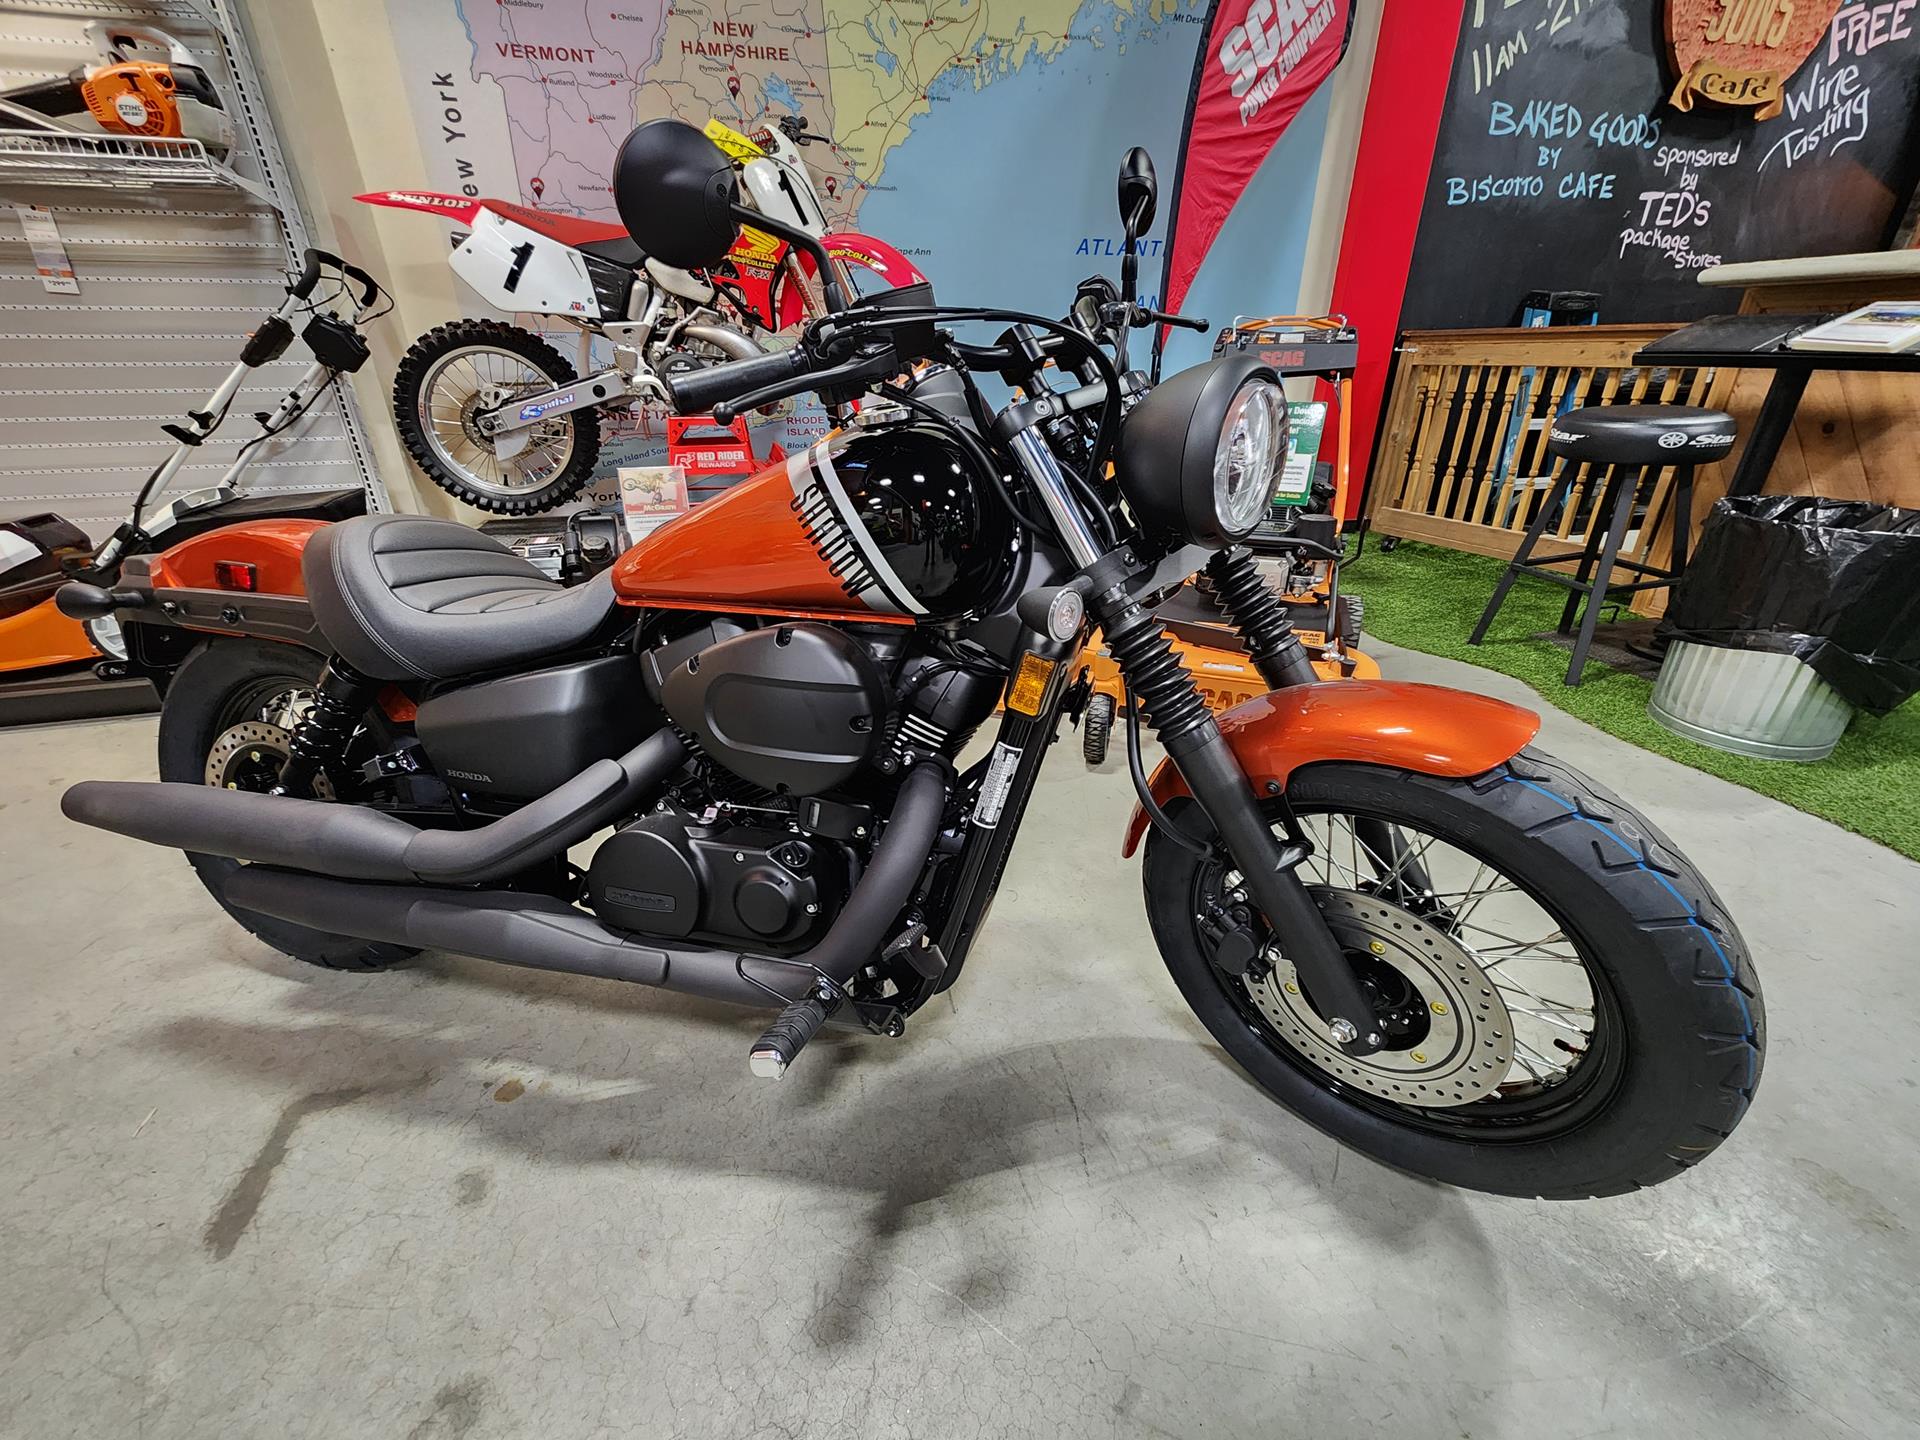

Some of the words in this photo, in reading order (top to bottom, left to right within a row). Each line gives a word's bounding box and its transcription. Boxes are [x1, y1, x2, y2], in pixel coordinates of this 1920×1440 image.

[617, 13, 644, 22] Chelsea
[1174, 13, 1185, 23] Mt
[1185, 14, 1206, 24] Dese
[713, 21, 754, 38] NEW
[1828, 0, 1917, 66] FREE
[496, 42, 595, 64] VERMONT
[681, 40, 790, 61] HAMPSHIRE
[1219, 0, 1319, 97] SCA
[549, 79, 575, 87] Rutland
[588, 70, 624, 79] Woodstock
[1239, 67, 1279, 127] POWER
[1785, 63, 1861, 121] Wine
[431, 72, 466, 143] York
[1488, 99, 1582, 139] BAKED
[1588, 111, 1662, 149] GOODS
[1757, 87, 1871, 173] Tasting
[1537, 145, 1563, 170] BY
[1653, 140, 1741, 177] Sponsored
[456, 158, 479, 197] ew
[1446, 174, 1543, 206] BISCOTTO
[1559, 171, 1617, 200] CAFE
[1680, 165, 1698, 191] by
[387, 191, 472, 209] DUNLOP
[778, 169, 808, 226] 1
[735, 247, 779, 264] HONDA
[914, 247, 932, 256] Ann
[1674, 250, 1722, 269] Stores
[503, 241, 535, 294] 1
[1259, 351, 1305, 367] SCAG
[786, 416, 825, 425] RHODE
[602, 457, 624, 467] Long
[624, 450, 650, 461] Island
[696, 451, 716, 461] RED
[716, 451, 744, 461] RIDER
[587, 491, 622, 502] York
[791, 483, 874, 598] SHADOW
[1197, 688, 1252, 710] CAG
[447, 769, 493, 783] HONDA
